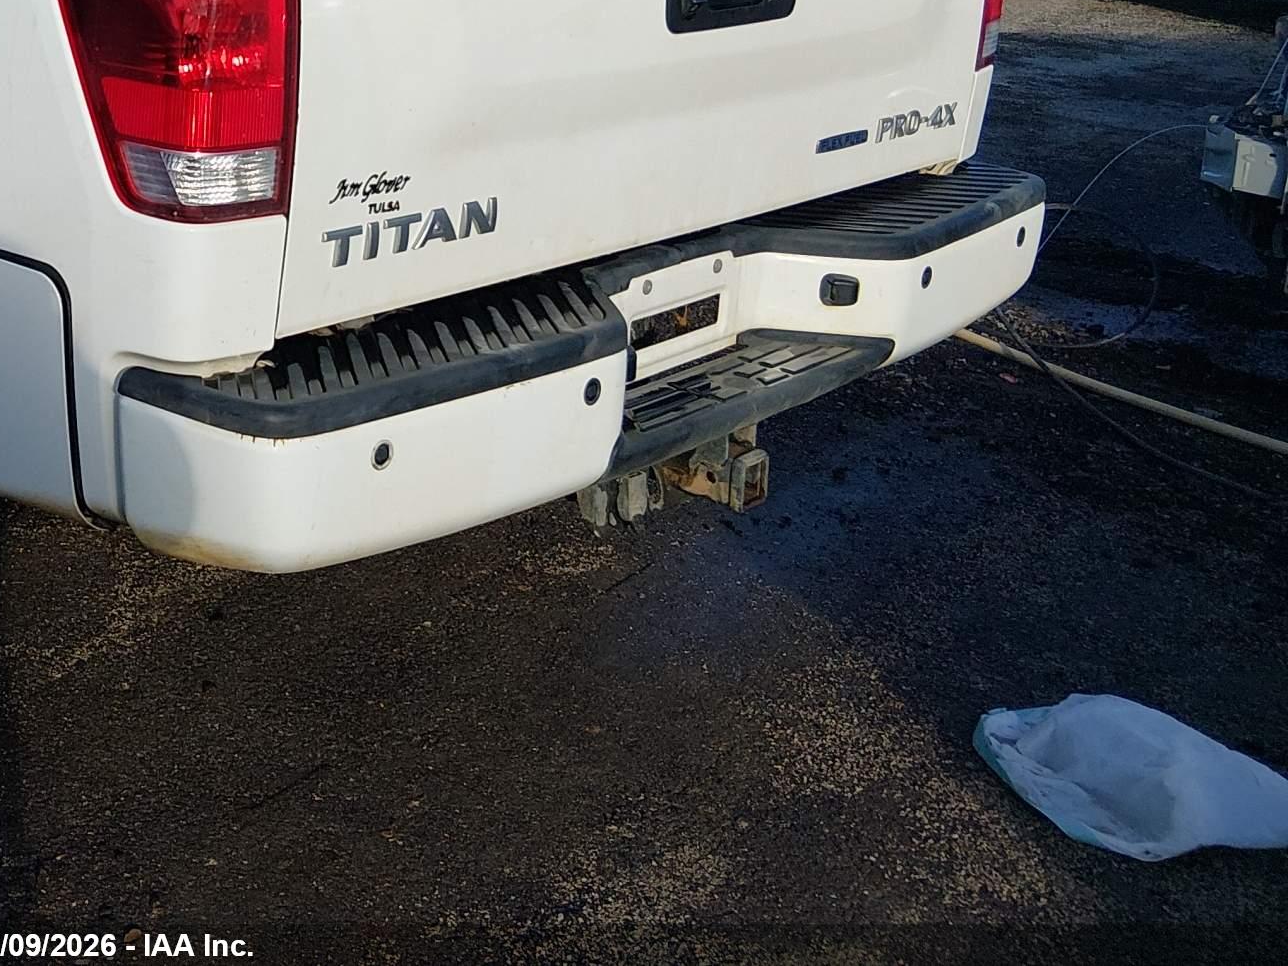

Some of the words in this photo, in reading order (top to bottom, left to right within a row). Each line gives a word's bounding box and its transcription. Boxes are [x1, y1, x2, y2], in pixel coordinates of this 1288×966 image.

[875, 101, 958, 144] PRO-4X
[361, 170, 411, 203] Glover
[368, 200, 401, 215] TULSA
[321, 196, 498, 268] TITAN
